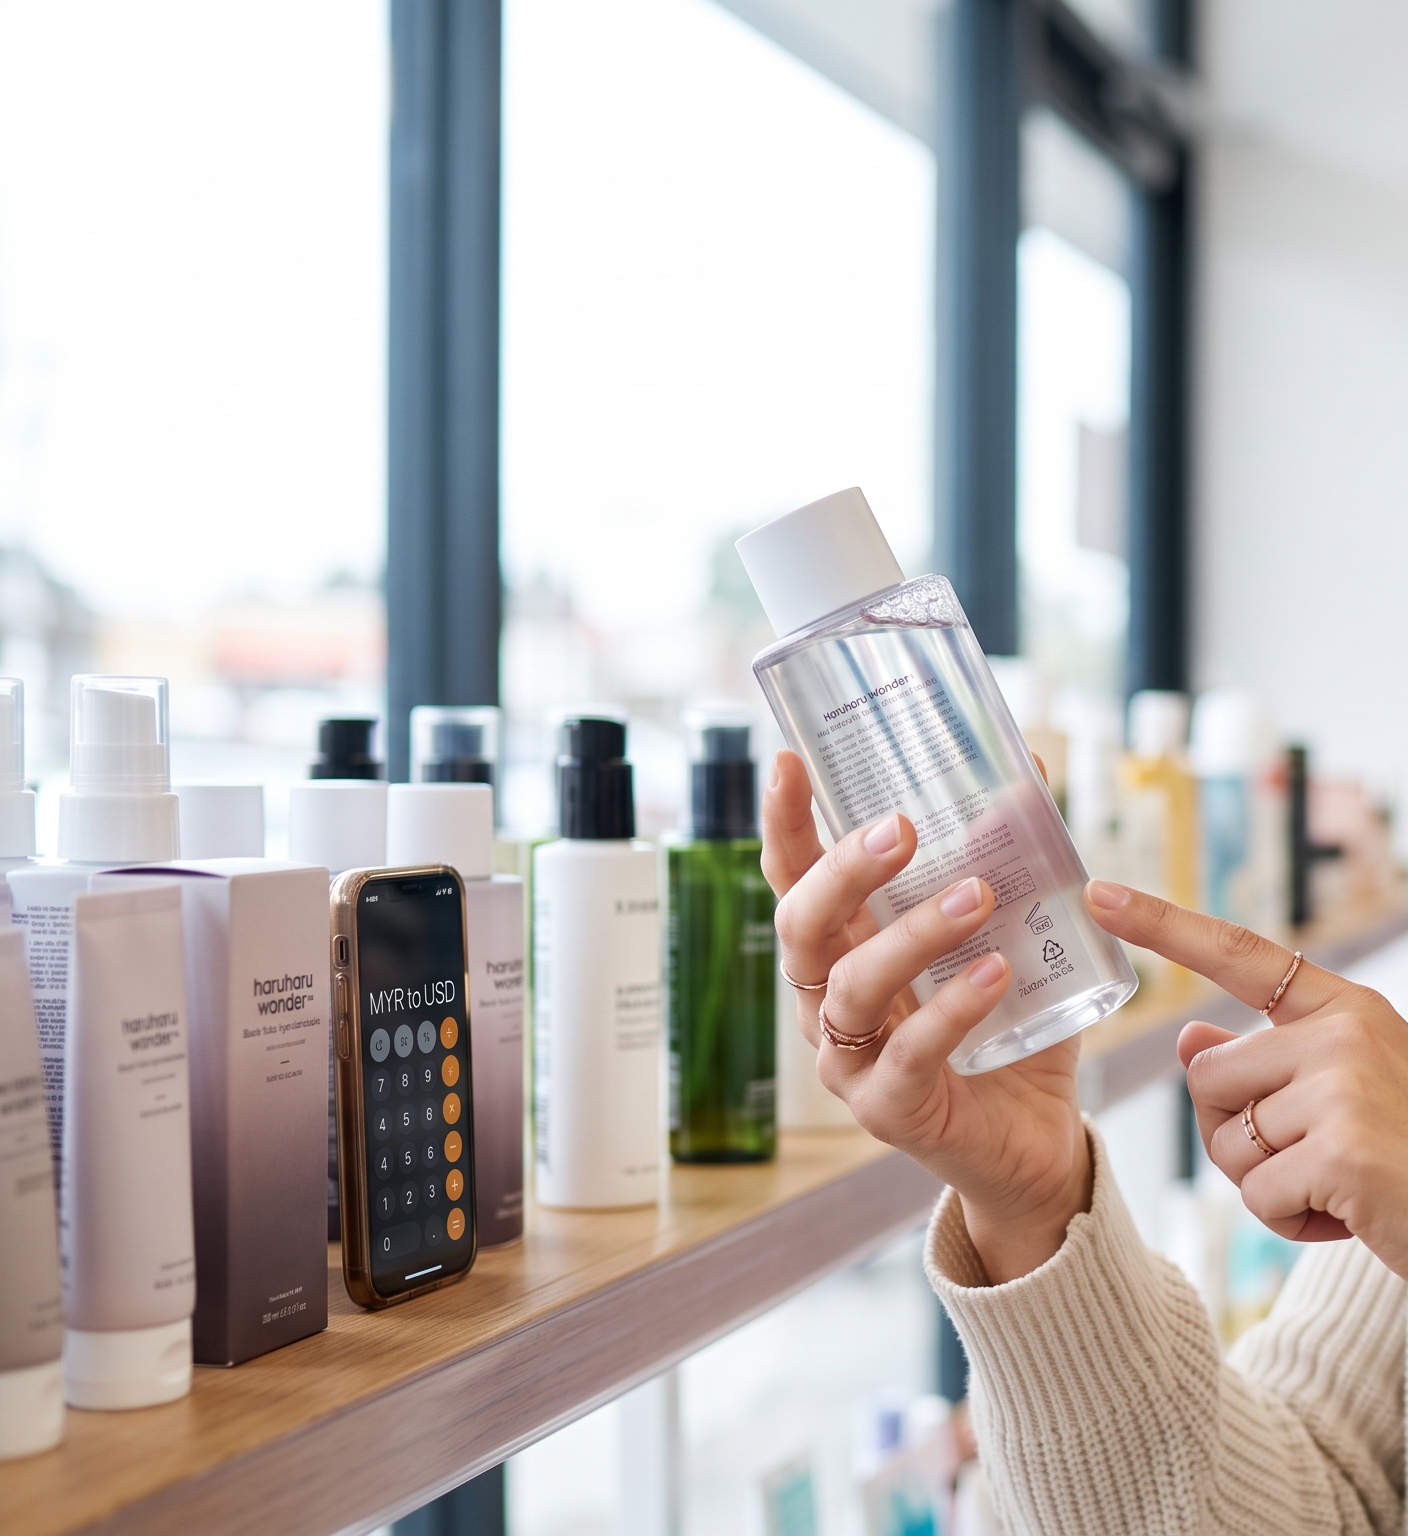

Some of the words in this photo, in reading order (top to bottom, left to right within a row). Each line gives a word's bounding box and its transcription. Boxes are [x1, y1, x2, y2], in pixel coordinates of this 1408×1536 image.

[253, 973, 313, 997] haruharu
[258, 993, 309, 1016] wonder
[369, 988, 405, 1015] MYR
[407, 988, 421, 1009] to
[424, 980, 455, 1006] USD
[378, 1079, 385, 1093] 7
[402, 1073, 409, 1087] 8
[425, 1069, 431, 1083] 9
[379, 1118, 386, 1131] 4
[403, 1112, 410, 1126] 5
[381, 1157, 388, 1171] 4
[405, 1151, 411, 1165] 5
[427, 1146, 434, 1160] 6
[382, 1197, 388, 1211] 1
[406, 1191, 413, 1205] 2
[429, 1184, 435, 1198] 3
[383, 1237, 390, 1251] 0
